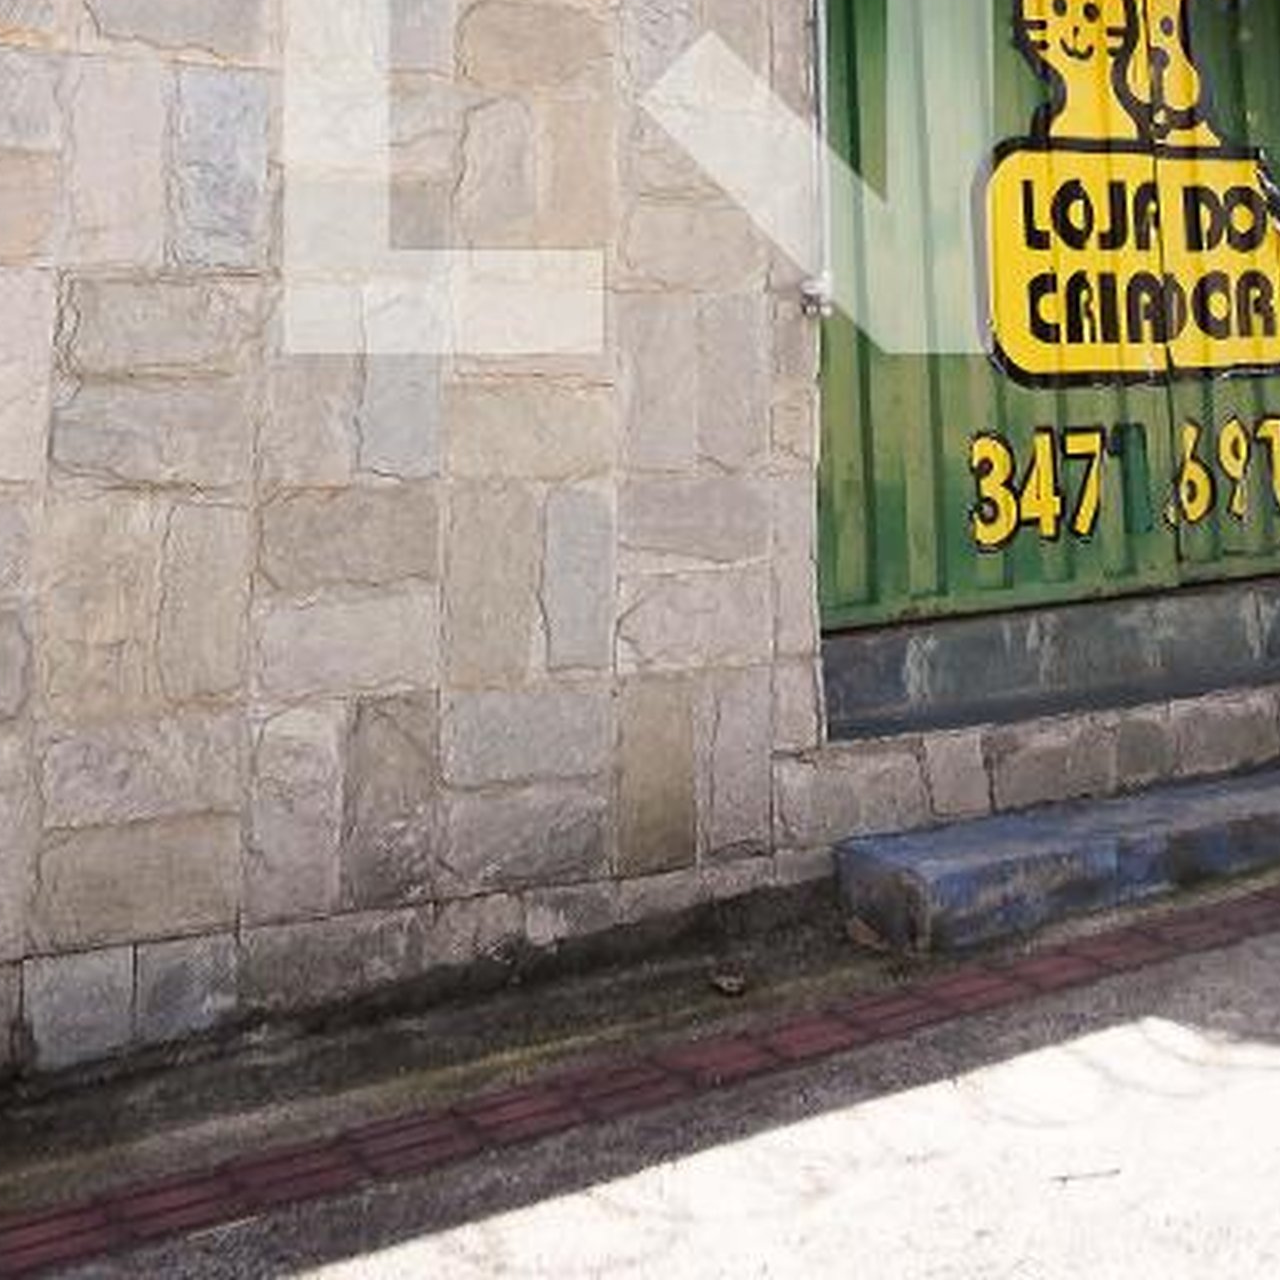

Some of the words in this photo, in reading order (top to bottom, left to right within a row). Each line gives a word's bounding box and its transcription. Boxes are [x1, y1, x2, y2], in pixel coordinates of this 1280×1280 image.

[1021, 177, 1161, 251] LOJA
[1182, 184, 1268, 253] DO
[1027, 269, 1277, 344] CRIADOR
